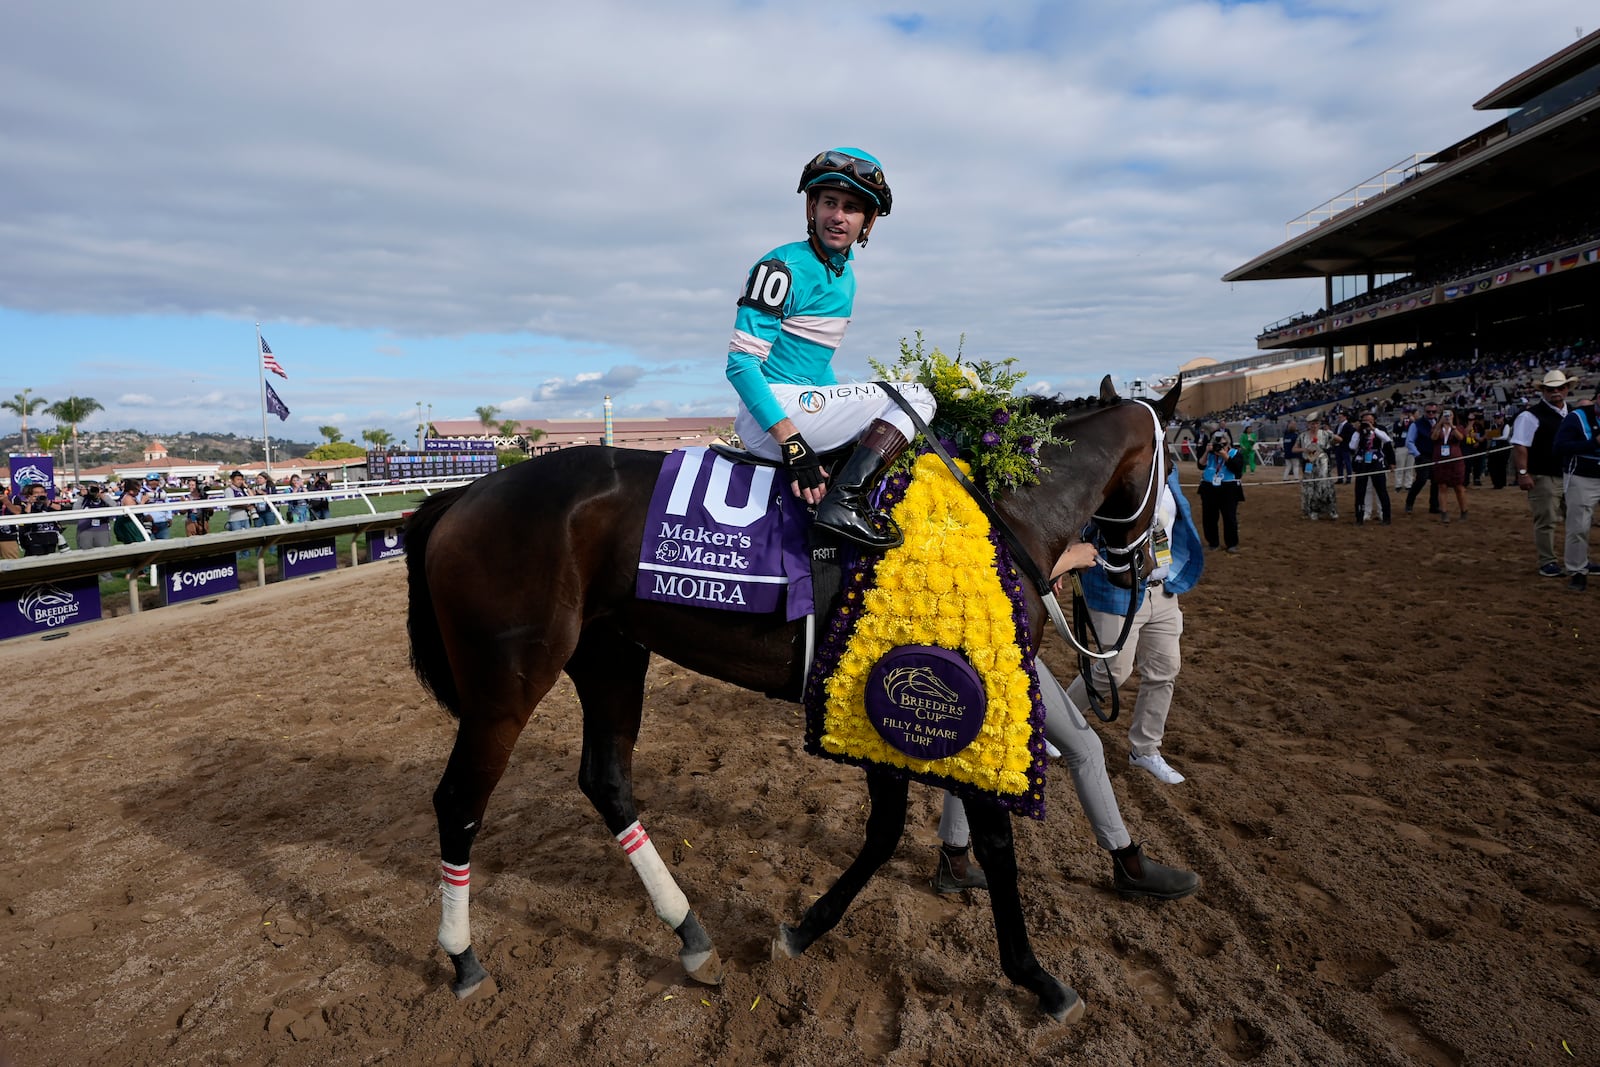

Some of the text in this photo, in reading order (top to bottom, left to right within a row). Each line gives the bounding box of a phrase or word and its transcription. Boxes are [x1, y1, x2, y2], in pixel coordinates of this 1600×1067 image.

[750, 264, 789, 307] 10
[665, 446, 776, 528] 10
[658, 522, 751, 549] Maker's
[299, 546, 334, 561] FANDUEL
[679, 545, 748, 569] Mark
[183, 566, 234, 587] Cygames
[652, 574, 747, 605] MOIRA
[34, 601, 80, 620] BREEDERS'
[47, 615, 66, 627] CUP
[900, 692, 967, 716] BREEDERS'
[915, 707, 942, 722] CUP
[883, 717, 958, 740] FILLY & MARE
[903, 732, 934, 747] TURF
